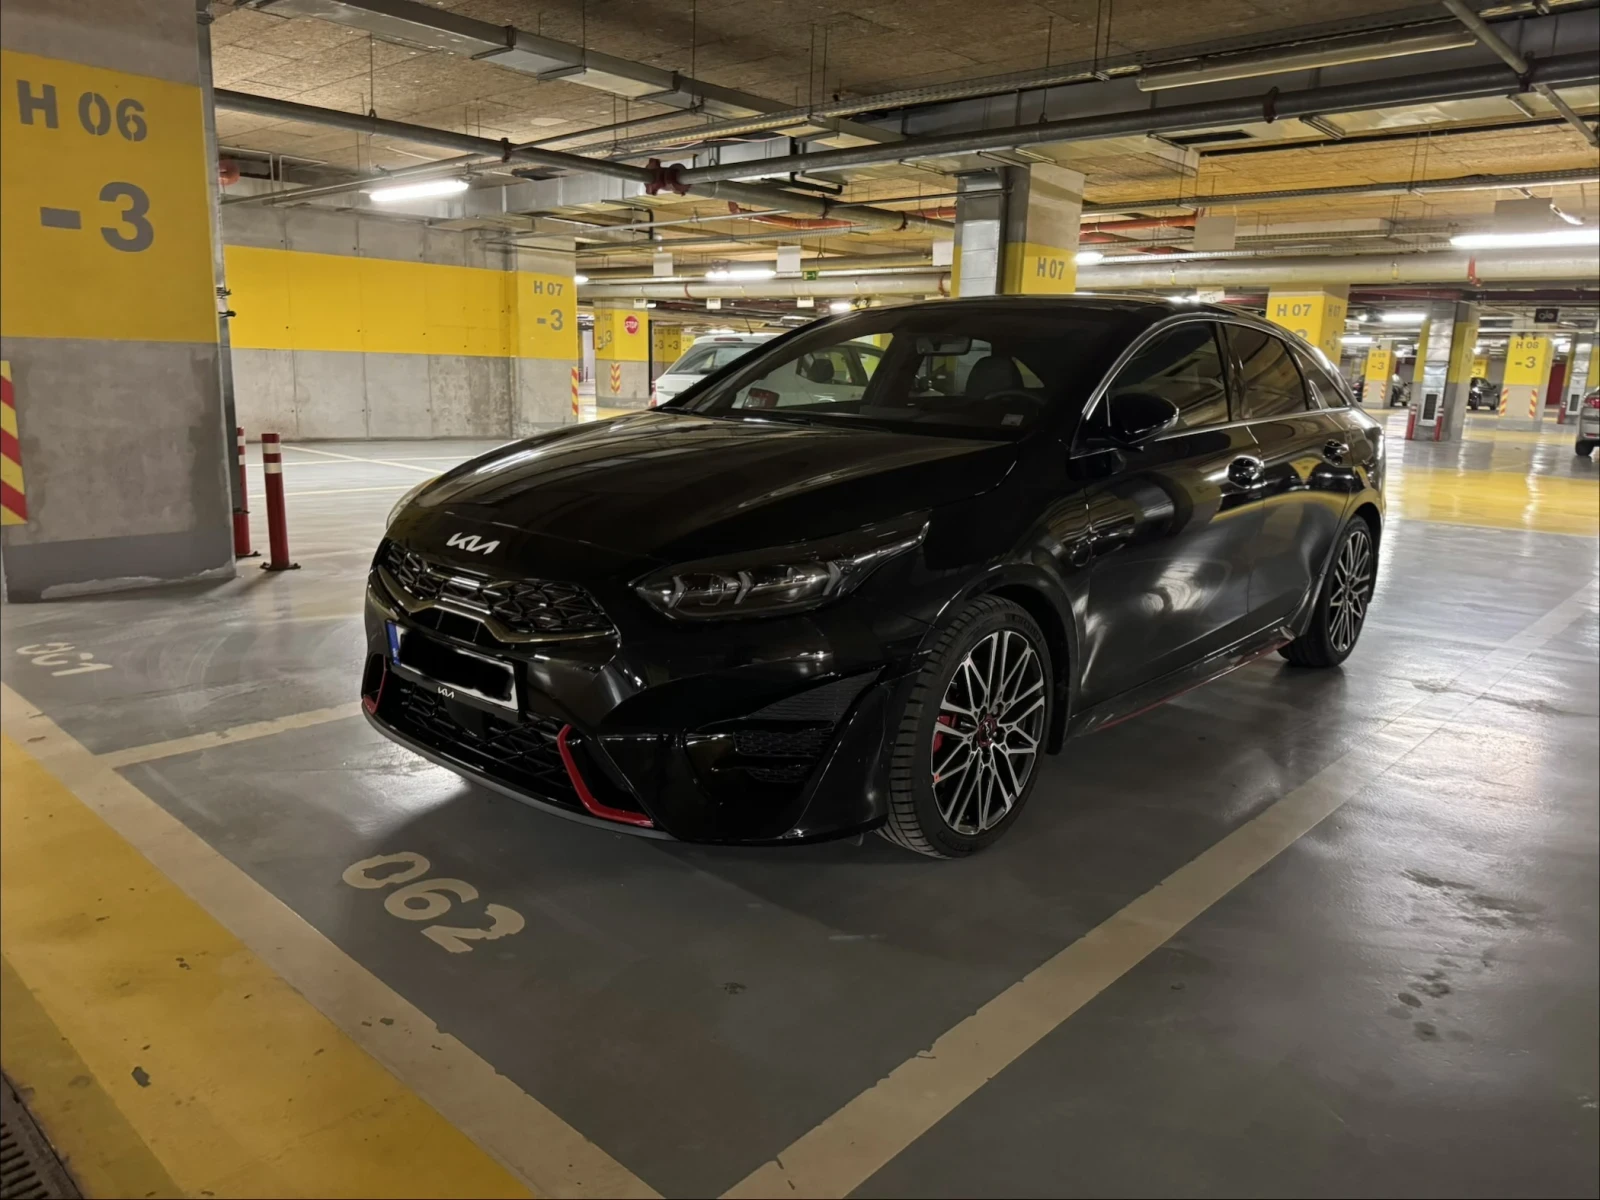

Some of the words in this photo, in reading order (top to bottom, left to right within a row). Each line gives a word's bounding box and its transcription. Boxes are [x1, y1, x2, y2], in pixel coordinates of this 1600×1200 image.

[16, 79, 59, 129] H
[78, 91, 148, 142] 06
[1037, 257, 1047, 277] H
[1049, 259, 1065, 280] 07
[533, 280, 543, 295] H
[547, 282, 563, 296] 07
[1276, 304, 1287, 317] H
[1292, 304, 1312, 317] 07
[625, 320, 639, 329] STOP
[1515, 341, 1524, 349] H
[446, 532, 500, 555] KIA
[437, 686, 455, 699] KIA
[342, 851, 525, 953] 062
